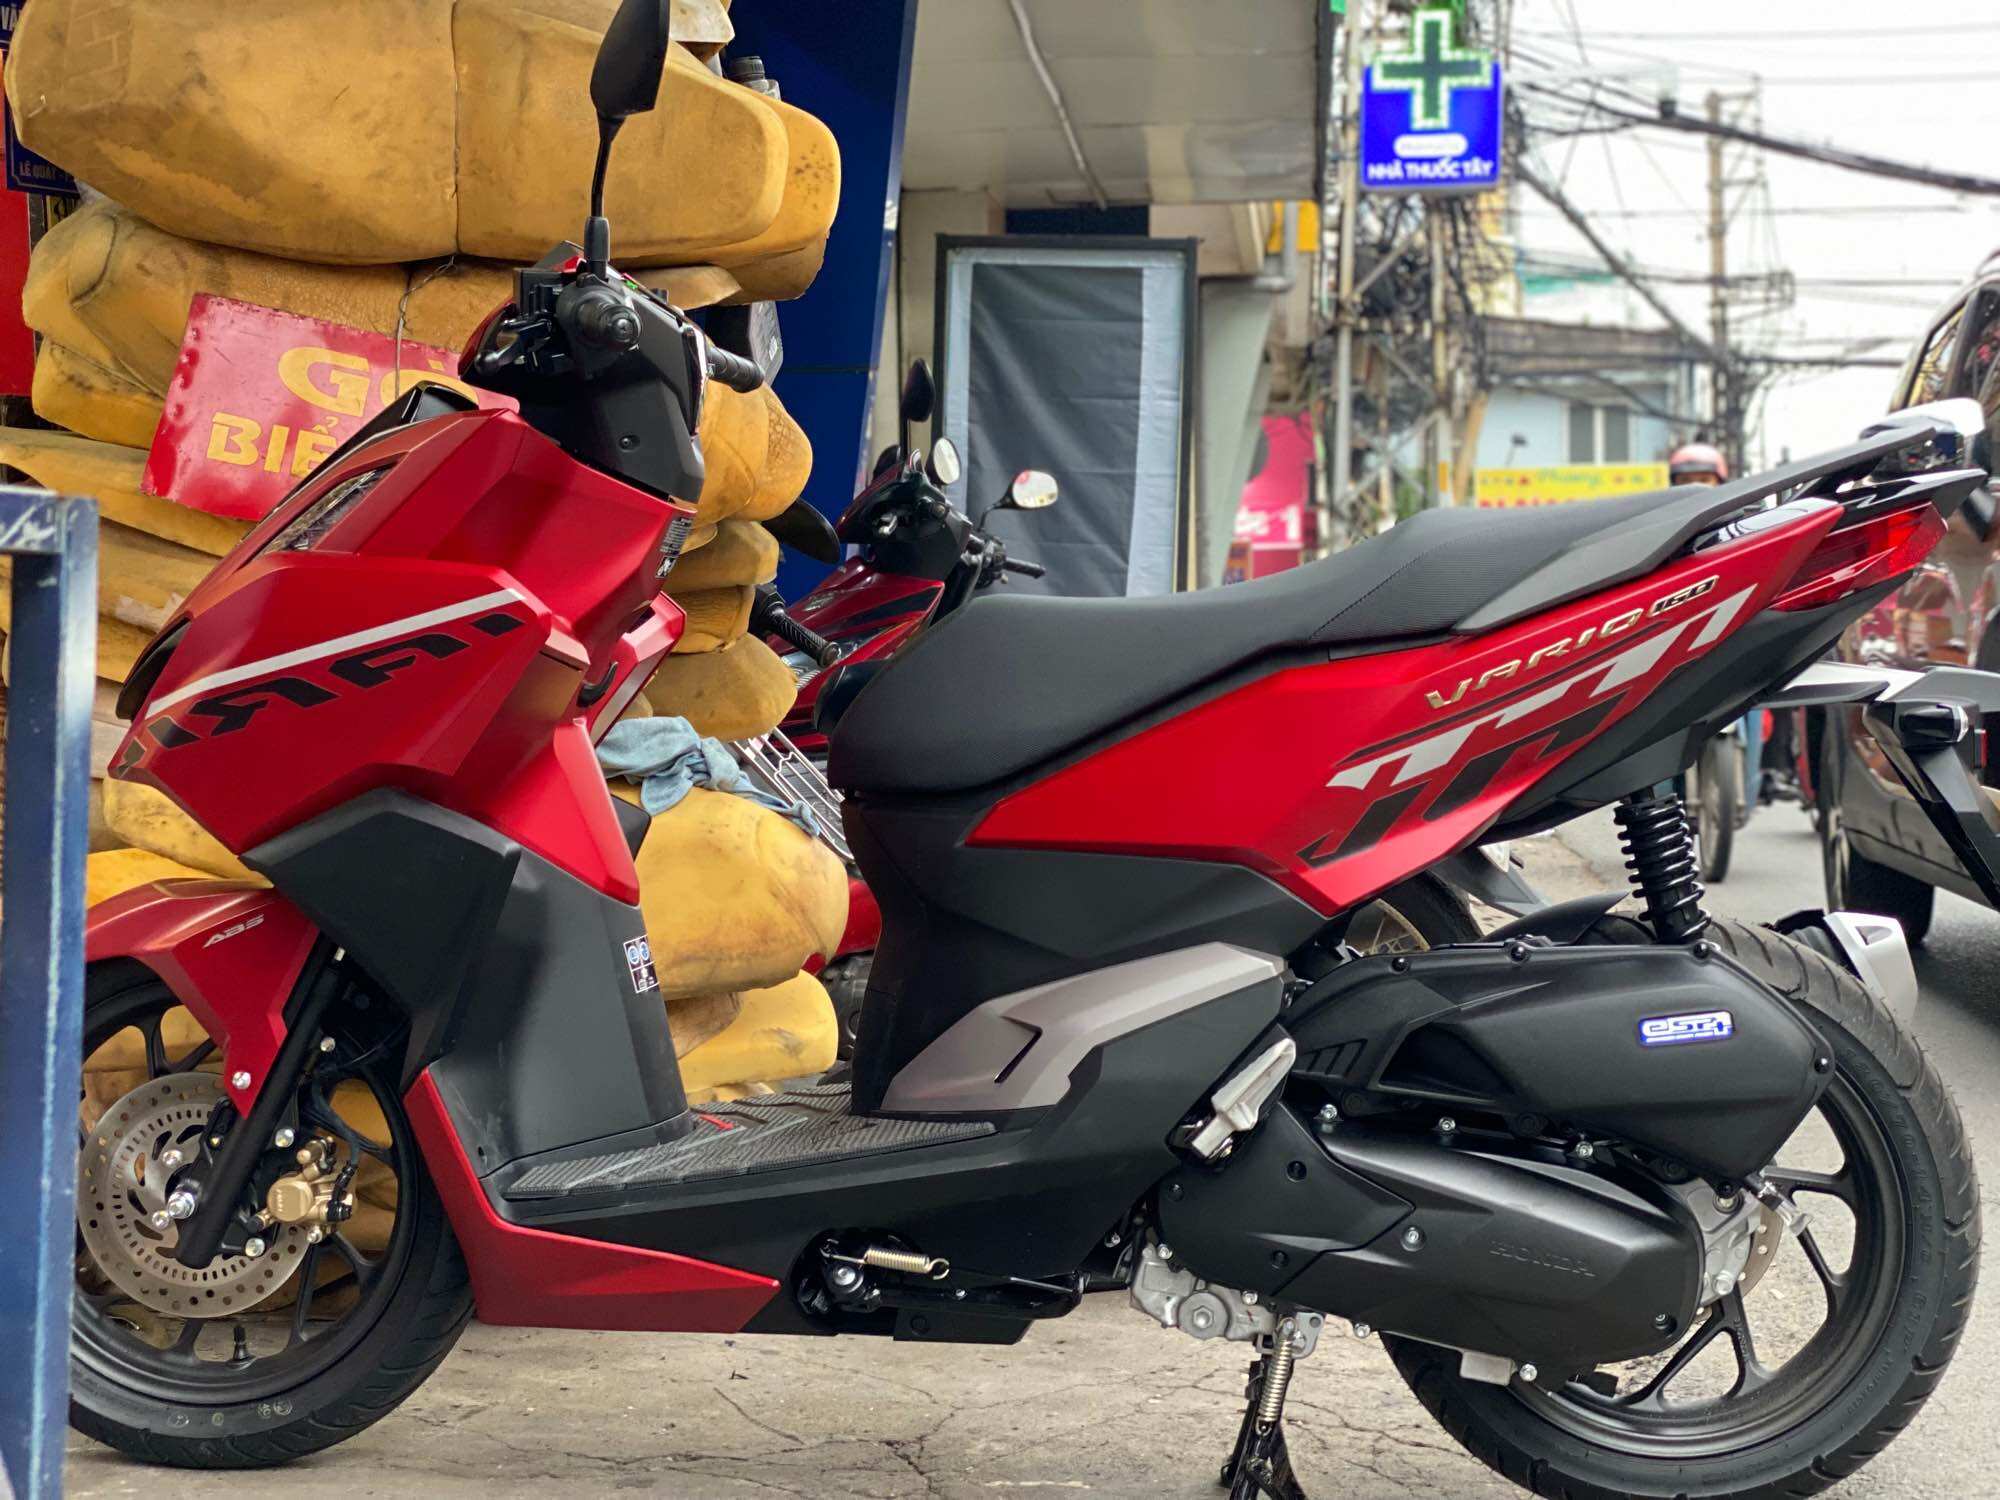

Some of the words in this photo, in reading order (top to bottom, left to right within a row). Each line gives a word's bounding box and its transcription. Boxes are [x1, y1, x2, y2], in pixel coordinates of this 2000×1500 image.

[1425, 608, 1644, 709] VARIO
[1649, 575, 1719, 617] 160
[202, 913, 264, 949] ABS
[1489, 1240, 1597, 1277] HONDA
